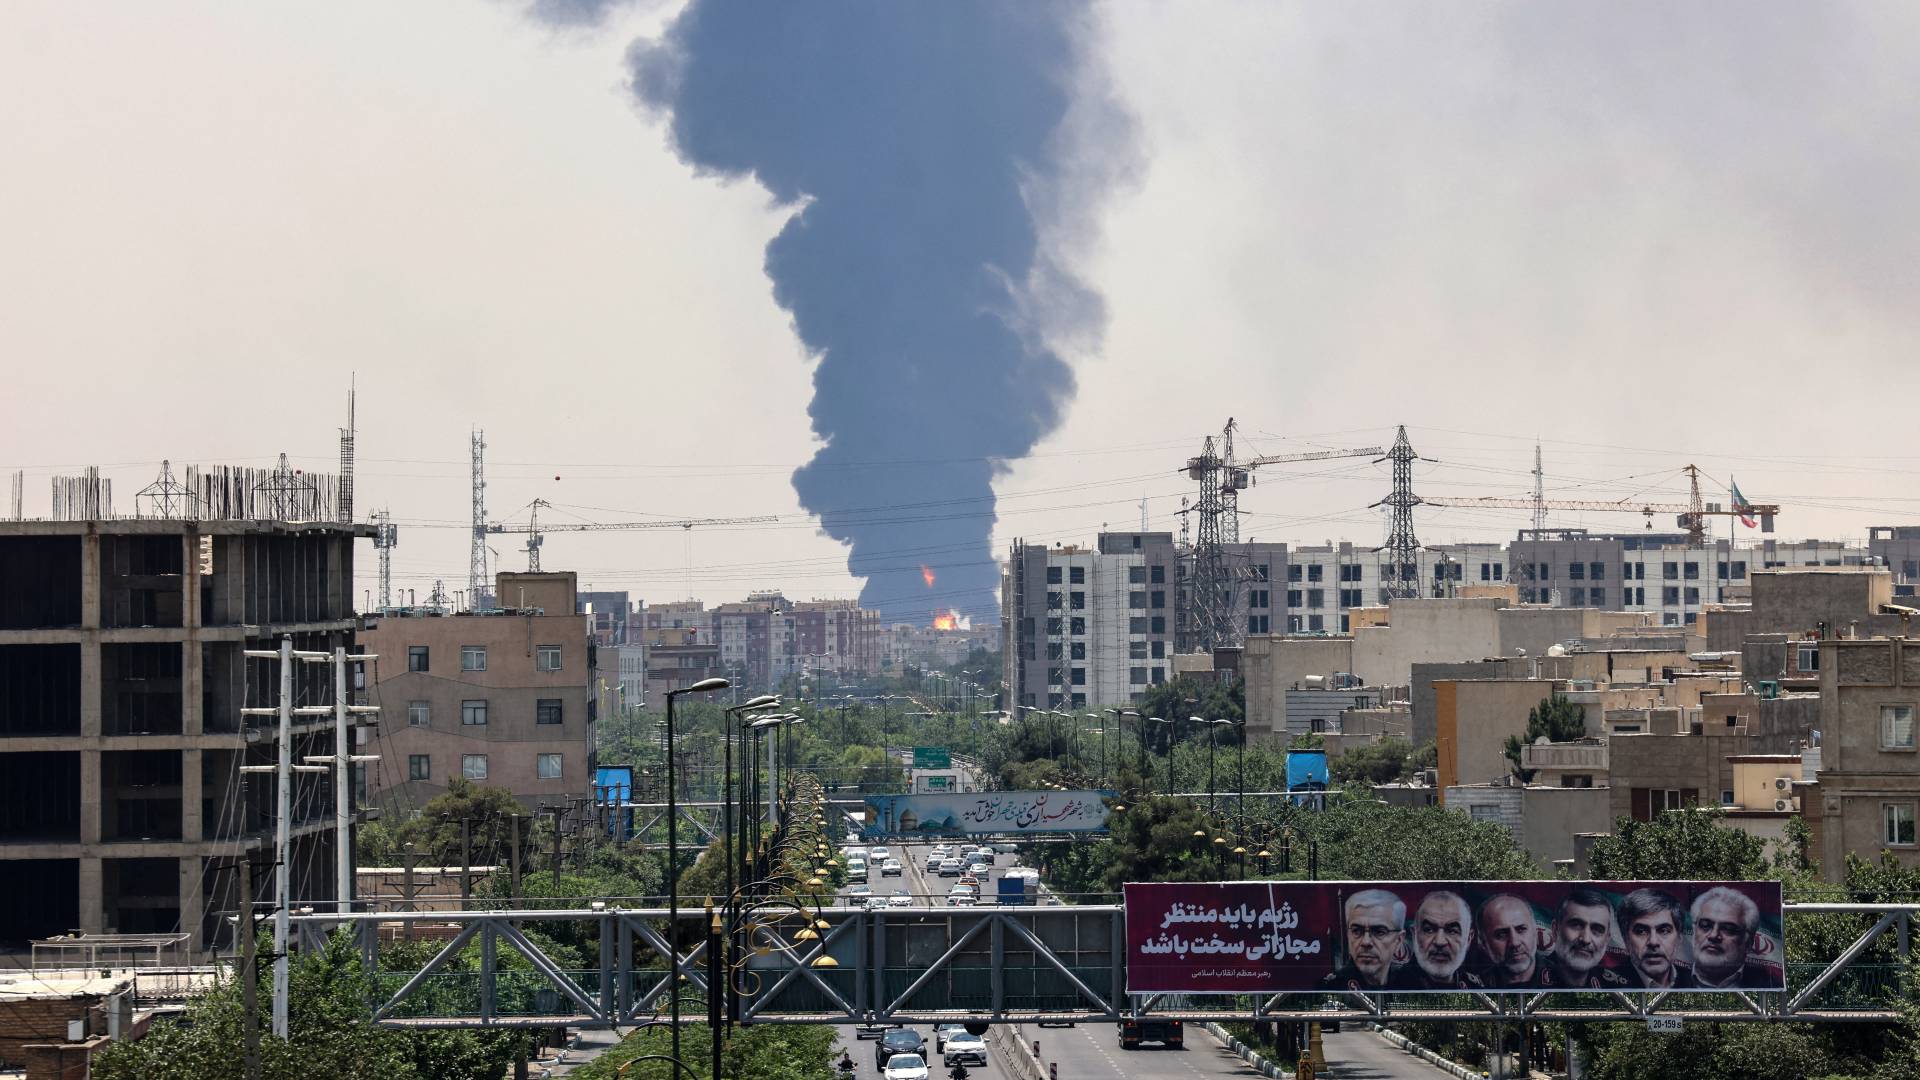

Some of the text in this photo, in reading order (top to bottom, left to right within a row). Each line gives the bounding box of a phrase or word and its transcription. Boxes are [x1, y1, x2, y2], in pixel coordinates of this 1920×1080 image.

[1160, 901, 1299, 929] رژیم باید منتظر
[1140, 931, 1321, 960] مجازاتی سخت باشد
[1191, 969, 1271, 979] رهبر معظم انقلاب اسلامی
[1653, 1020, 1676, 1028] 20-159
